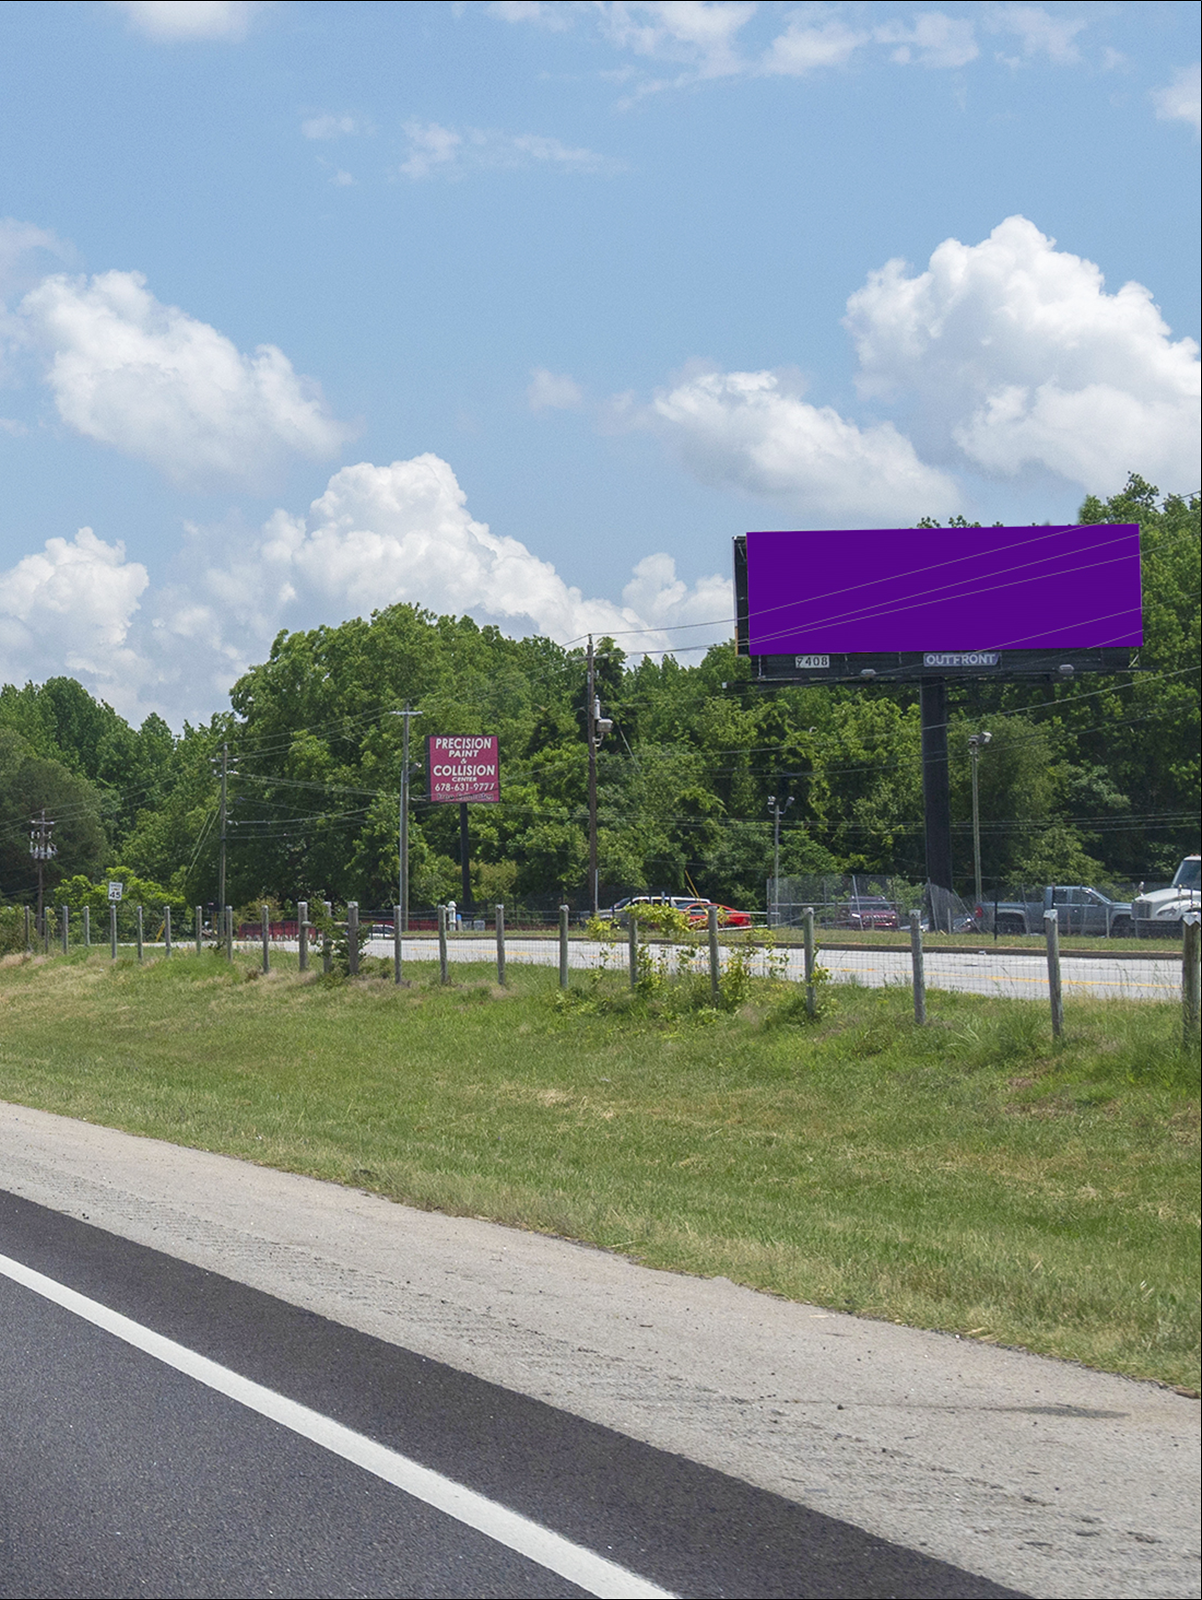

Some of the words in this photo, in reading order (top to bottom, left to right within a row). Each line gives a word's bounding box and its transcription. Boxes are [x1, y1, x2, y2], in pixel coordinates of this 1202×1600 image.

[797, 656, 828, 667] 7408
[926, 654, 996, 665] OUTFRONT
[435, 738, 492, 749] PRECISION
[448, 750, 479, 758] PAINT
[433, 765, 495, 777] COLLISION
[434, 783, 495, 792] 678-631-9777
[109, 891, 121, 899] 45
